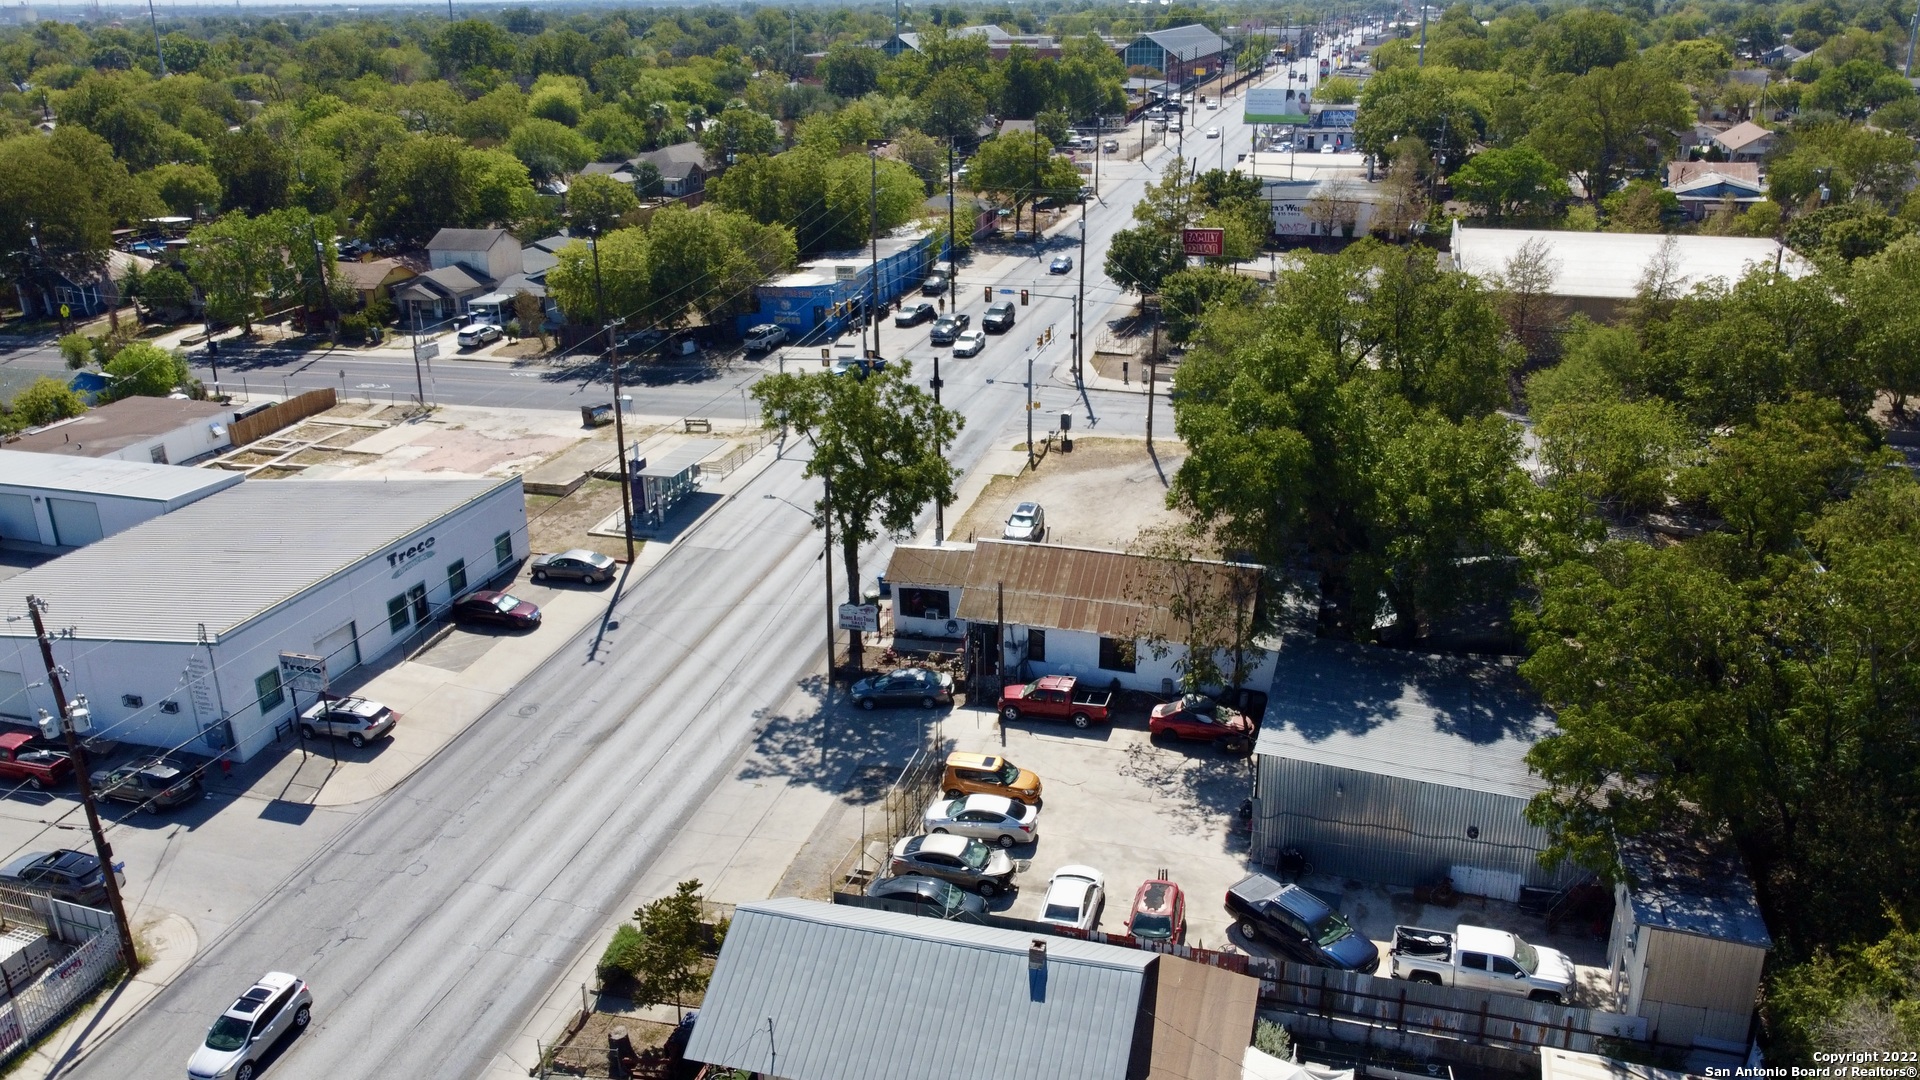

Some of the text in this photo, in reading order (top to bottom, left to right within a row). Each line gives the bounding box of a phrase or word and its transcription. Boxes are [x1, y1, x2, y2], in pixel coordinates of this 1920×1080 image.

[1186, 232, 1219, 242] FAMILY
[1186, 244, 1218, 254] DOLLAR
[386, 537, 436, 568] Treco
[281, 661, 321, 673] Treco
